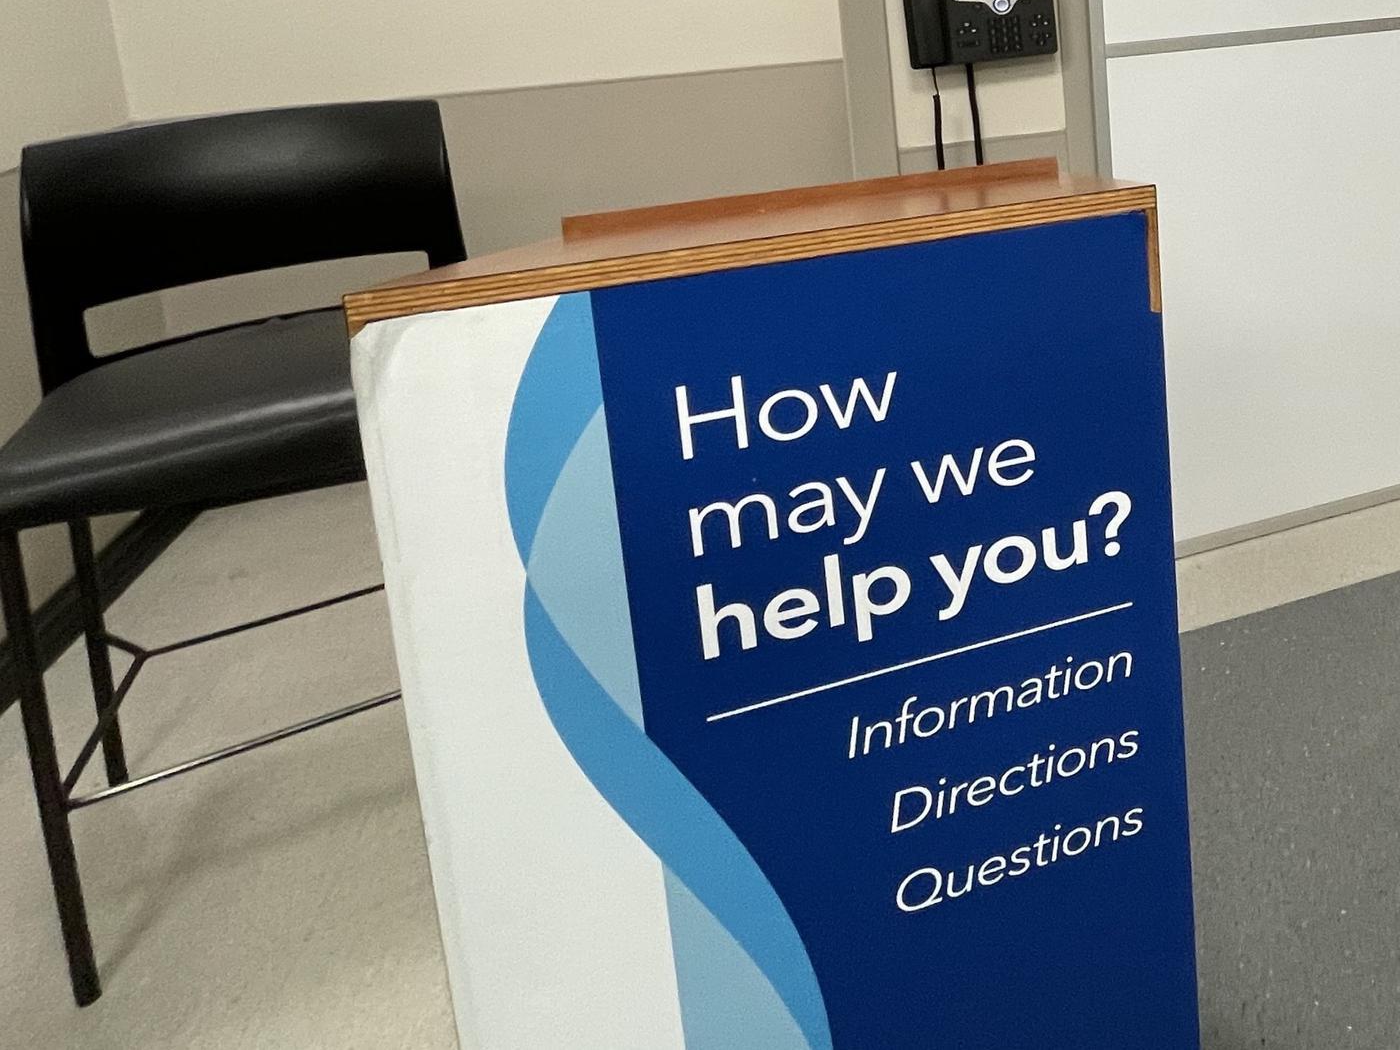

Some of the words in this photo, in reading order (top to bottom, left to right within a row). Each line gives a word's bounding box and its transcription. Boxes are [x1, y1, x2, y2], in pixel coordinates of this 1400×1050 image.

[675, 371, 897, 459] How
[688, 468, 886, 557] may
[910, 438, 1037, 504] we
[696, 555, 911, 660] help
[929, 490, 1133, 621] you?
[846, 650, 1134, 759] Information
[890, 730, 1139, 833] Directions
[895, 806, 1145, 913] Questions
